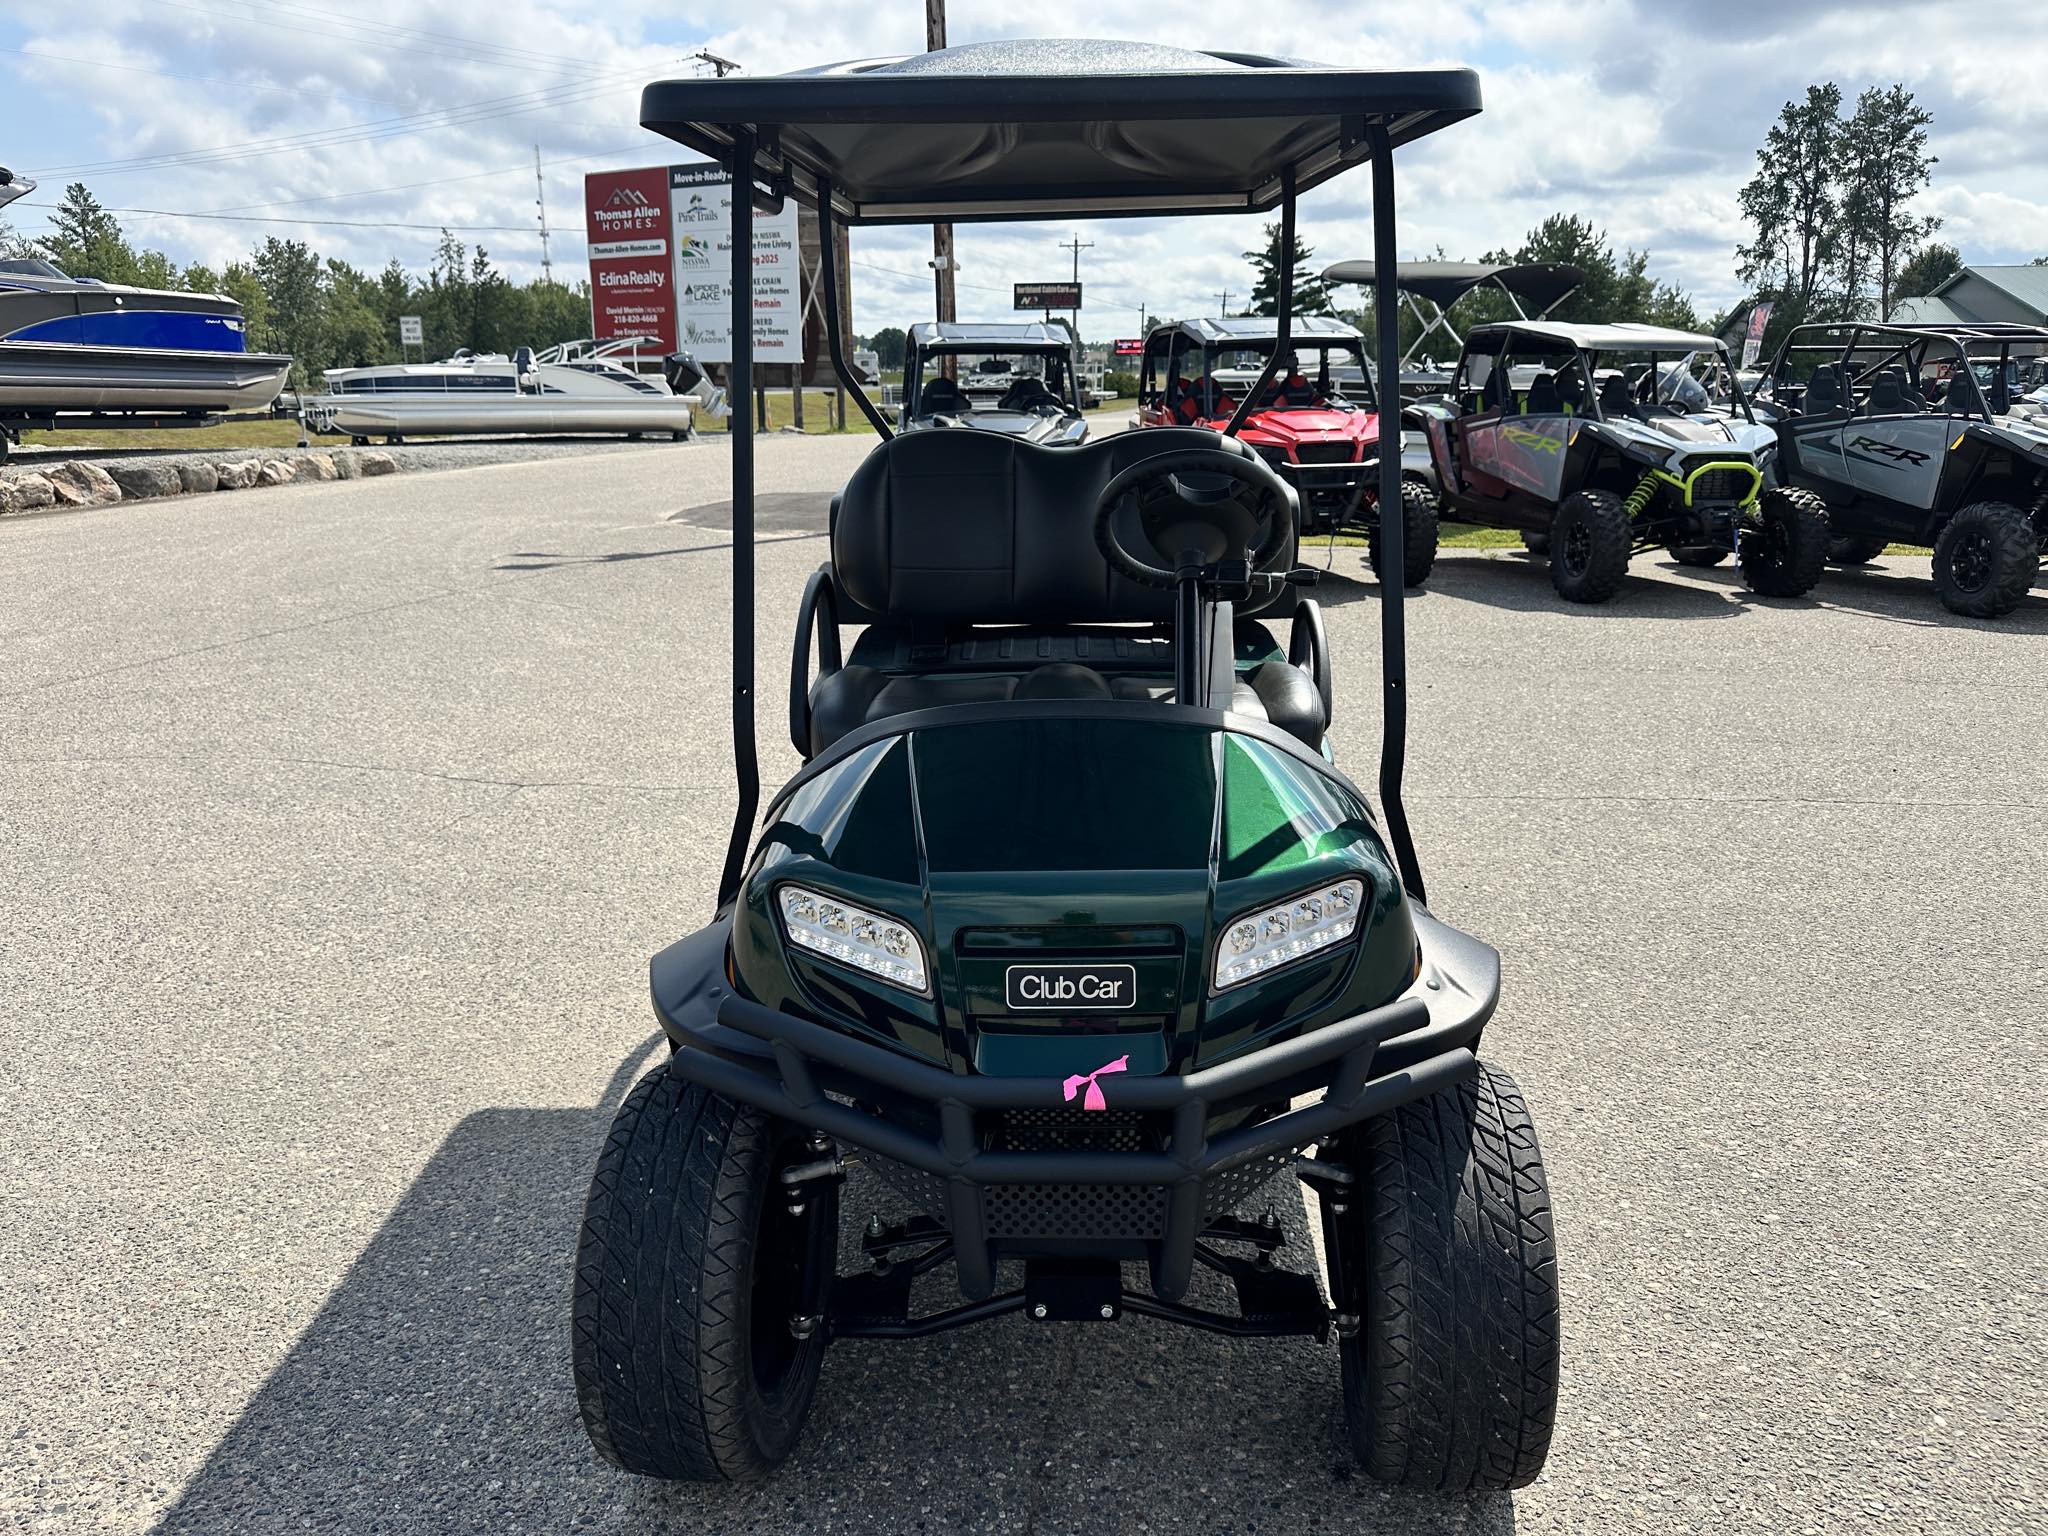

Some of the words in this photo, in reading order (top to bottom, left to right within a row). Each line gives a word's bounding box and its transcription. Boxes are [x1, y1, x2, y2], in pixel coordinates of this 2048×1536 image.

[594, 210, 632, 221] Thomas
[634, 207, 661, 218] Allen
[678, 212, 696, 223] Pine
[697, 210, 719, 222] Trails
[602, 218, 652, 232] HOMES
[757, 241, 771, 249] Free
[772, 240, 792, 250] Living
[760, 254, 779, 264] 2025
[694, 291, 721, 301] LAKE
[754, 298, 782, 309] Remain
[757, 338, 784, 348] Remain
[1497, 424, 1563, 455] RZR
[1848, 436, 1932, 467] RZR
[1019, 974, 1077, 999] Club
[1078, 974, 1123, 999] Car
